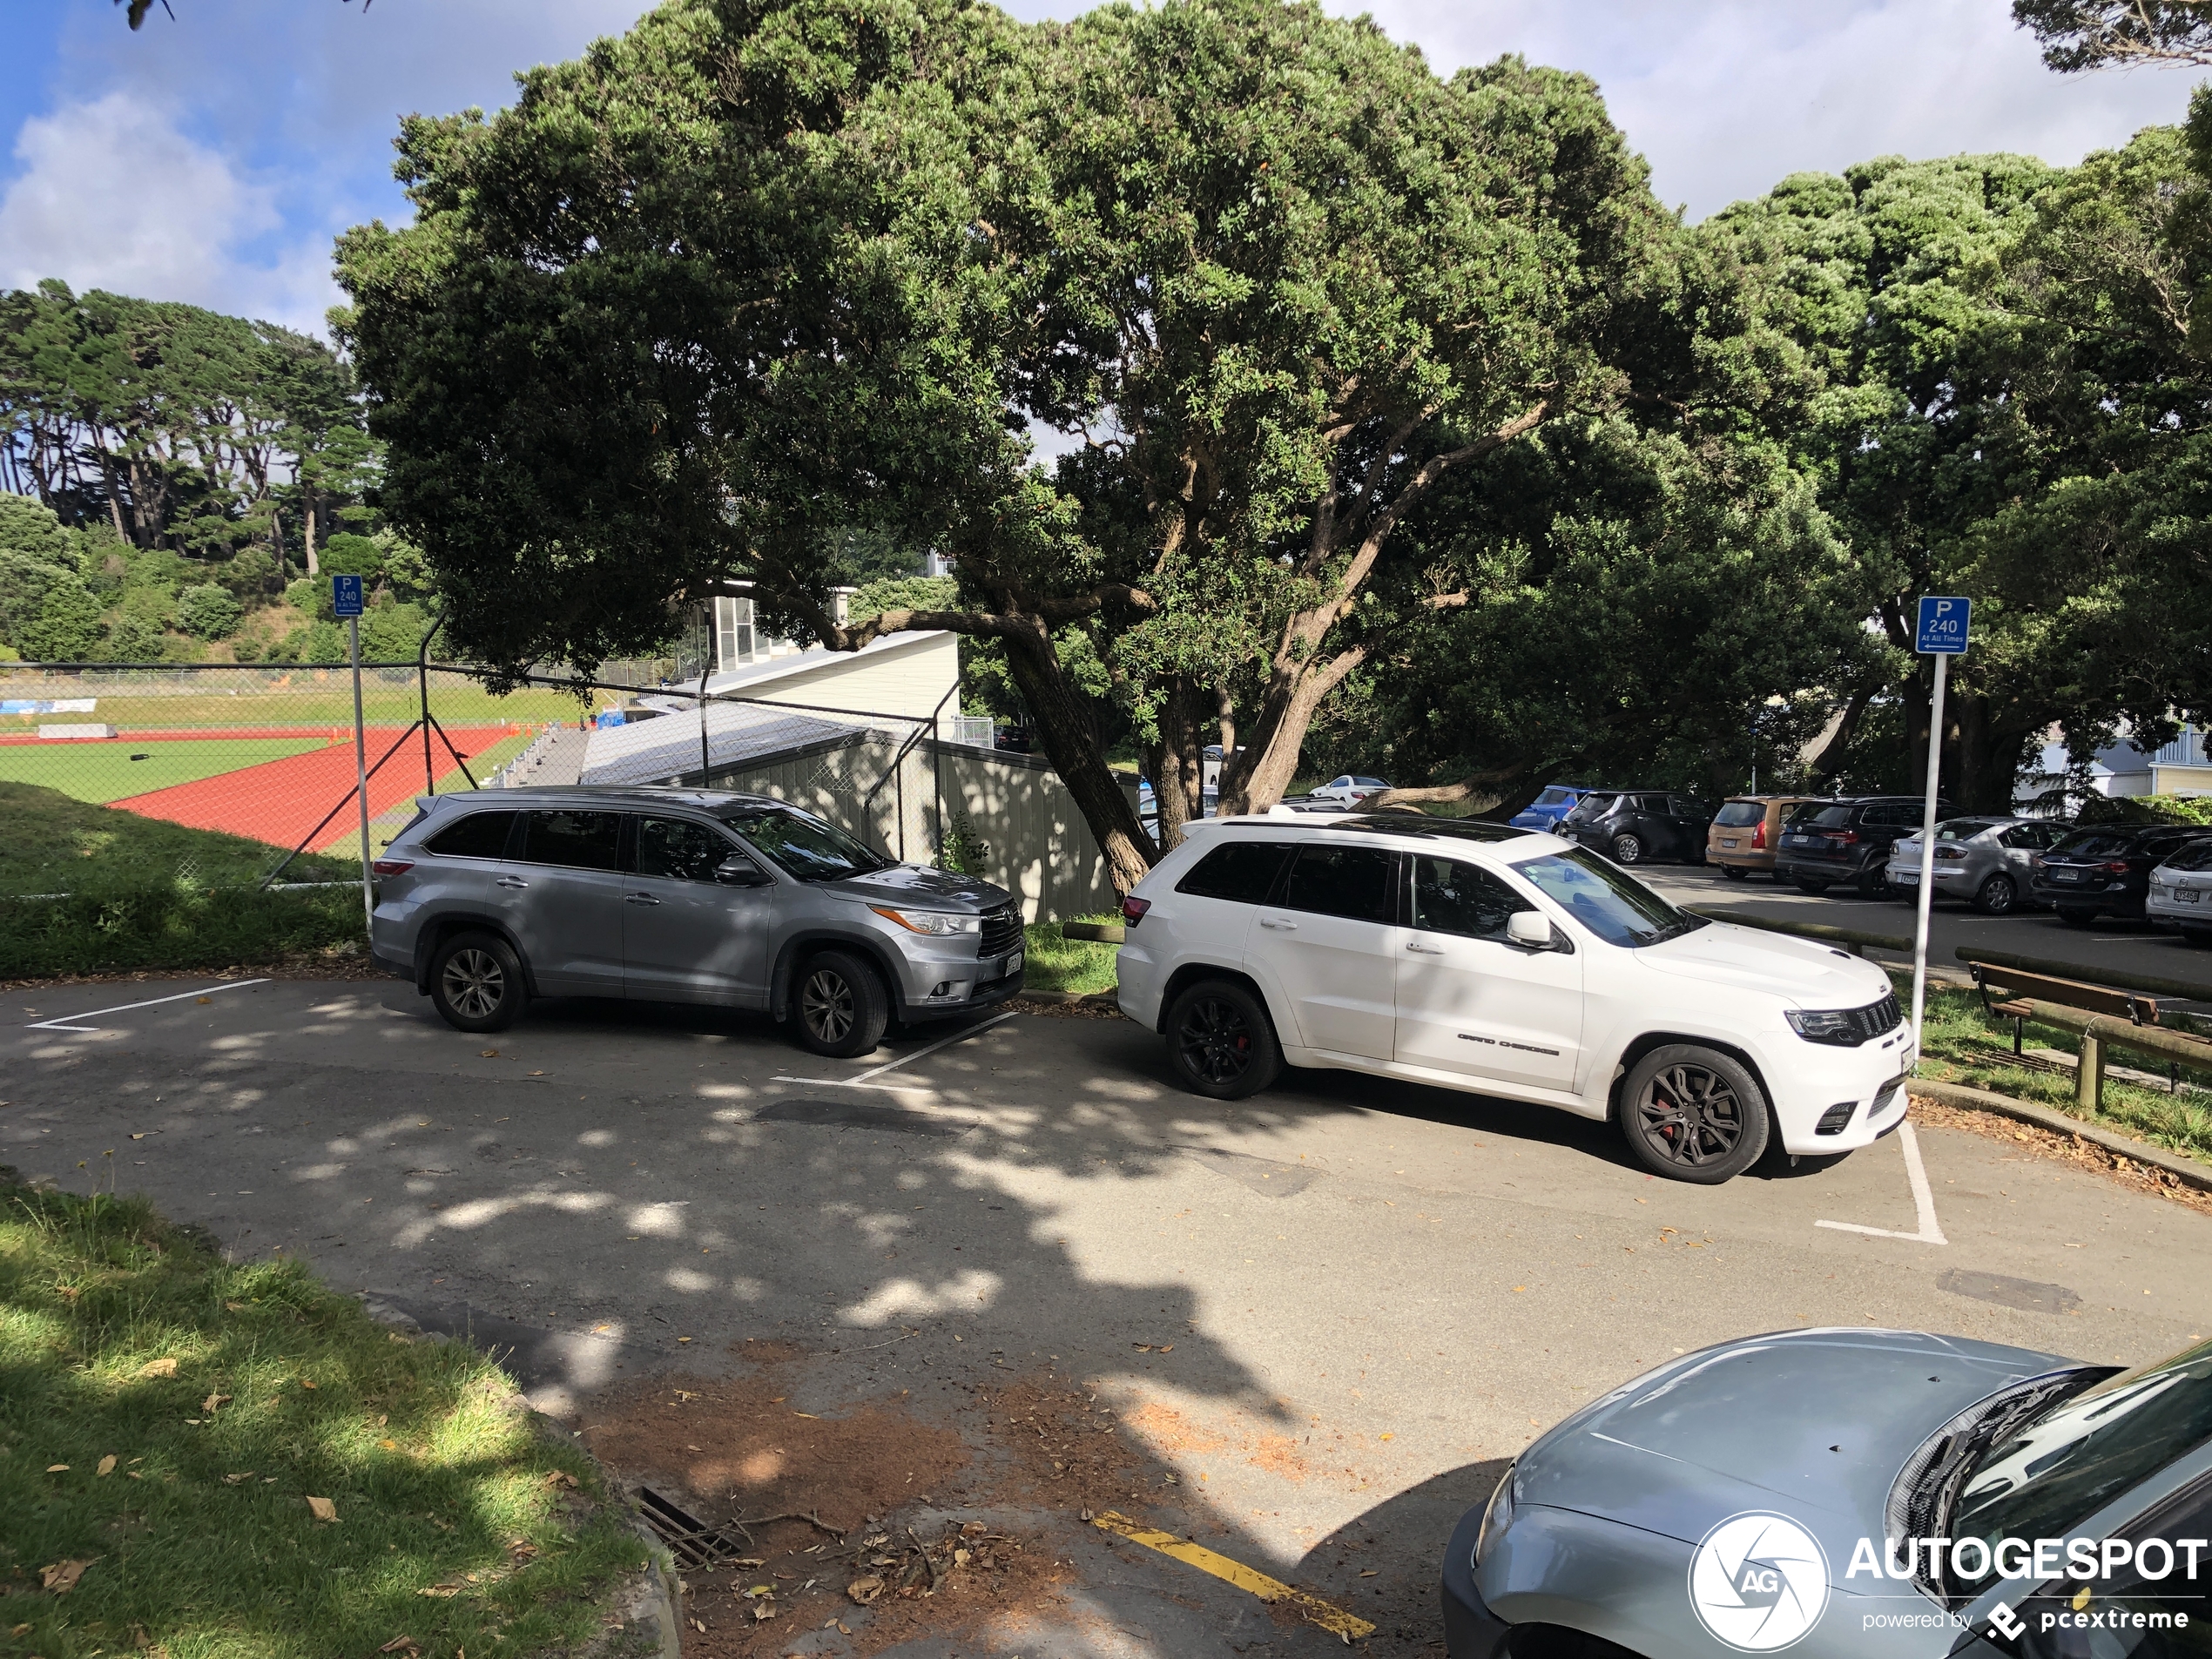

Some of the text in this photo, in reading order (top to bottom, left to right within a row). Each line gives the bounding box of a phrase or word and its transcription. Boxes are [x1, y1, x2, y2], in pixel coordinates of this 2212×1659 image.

[342, 577, 352, 590] P
[340, 591, 356, 601] 240
[1937, 600, 1952, 617] P
[1929, 619, 1958, 633] 240
[1457, 1033, 1560, 1056] GRAND CHEROKEE
